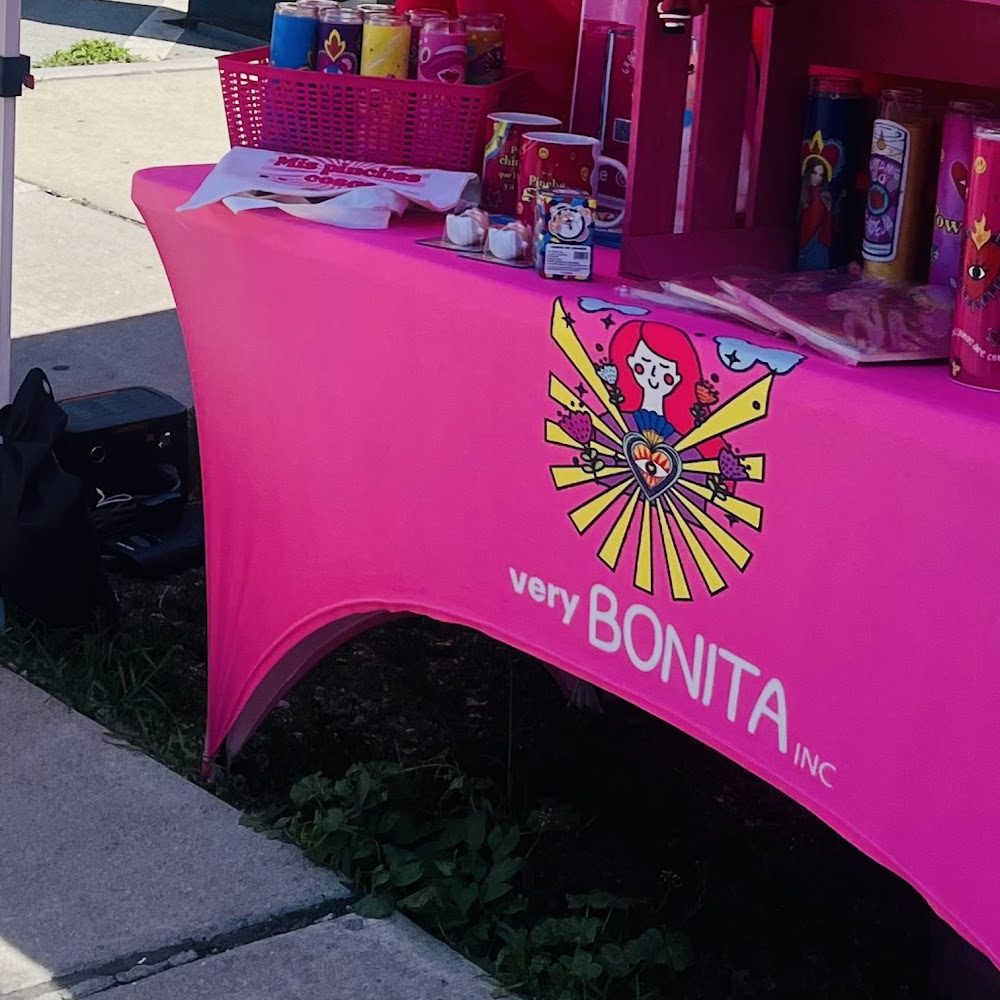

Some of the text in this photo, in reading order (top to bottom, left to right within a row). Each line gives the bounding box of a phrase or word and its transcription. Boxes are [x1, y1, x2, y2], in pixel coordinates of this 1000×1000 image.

[273, 156, 422, 184] Mis pinches
[509, 567, 837, 789] very BONITA INC
